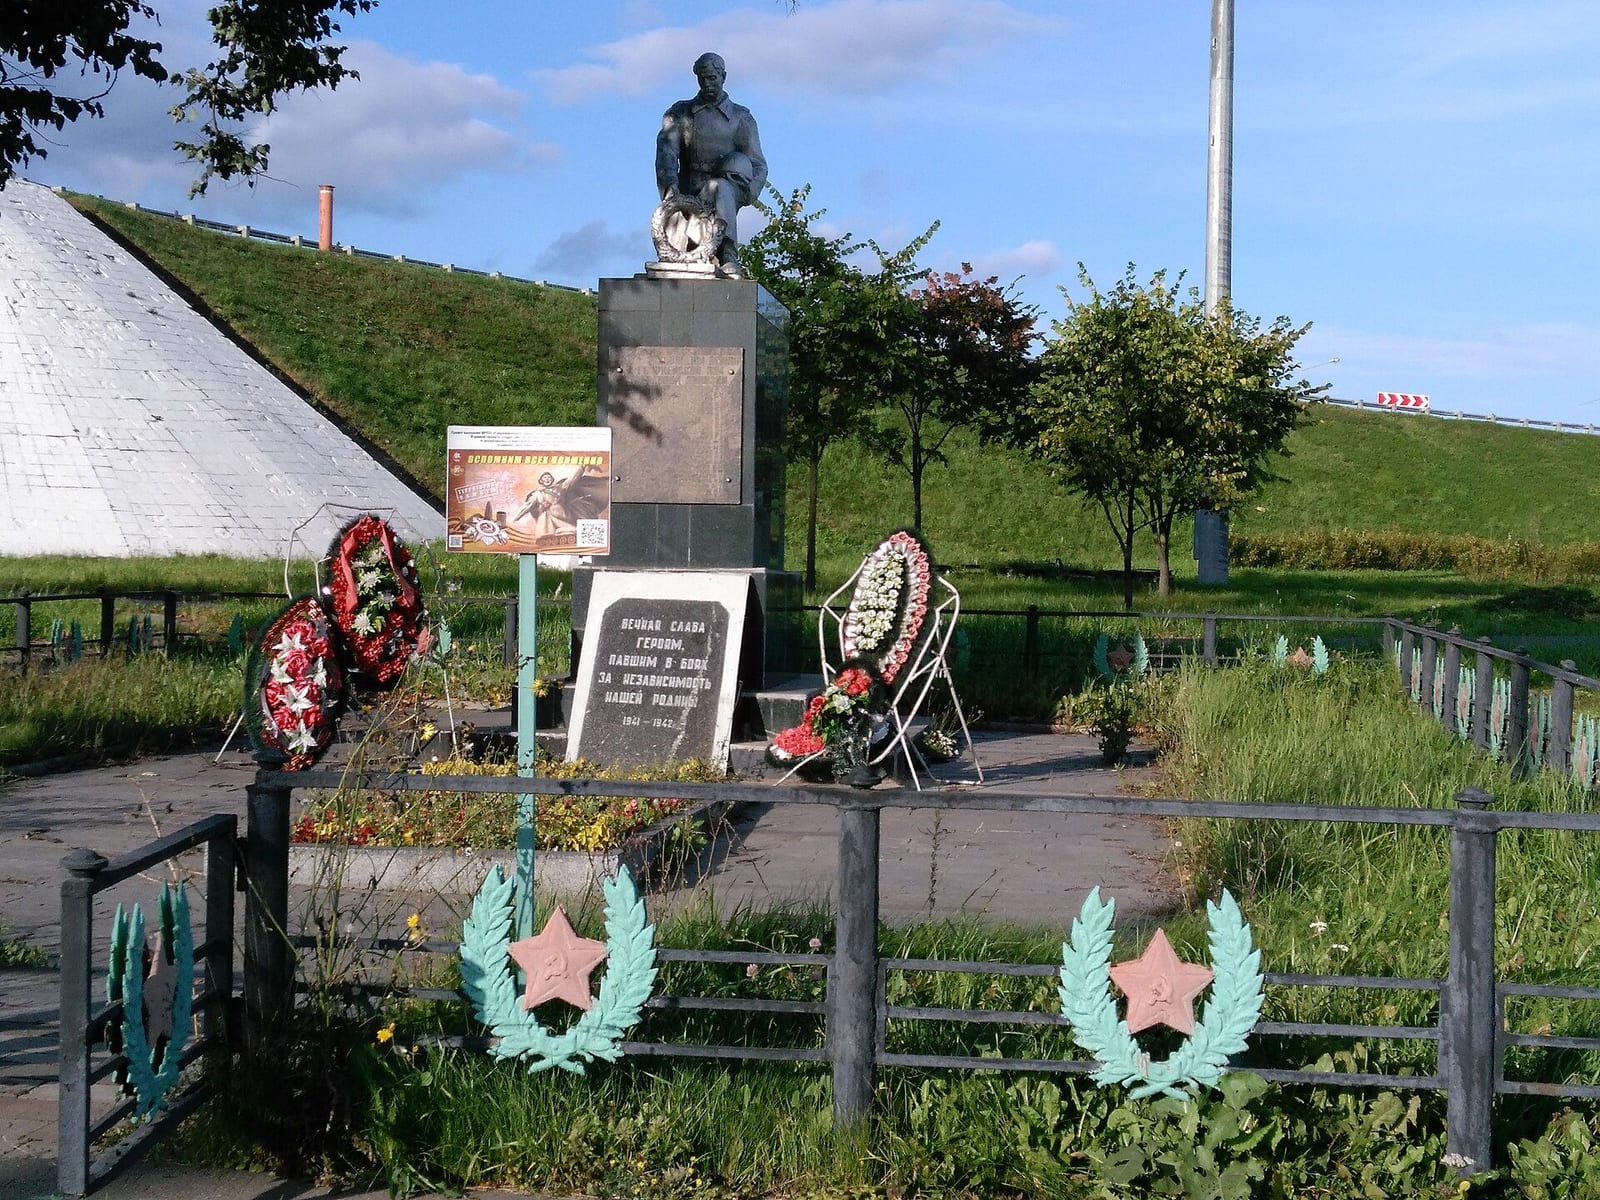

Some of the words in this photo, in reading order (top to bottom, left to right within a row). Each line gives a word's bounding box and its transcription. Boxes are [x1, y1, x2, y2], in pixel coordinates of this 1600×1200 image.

[467, 455, 523, 465] ВСПОМНИМ
[524, 455, 549, 465] ВСЕХ
[621, 618, 661, 630] ВЕЧНАЯ
[670, 620, 705, 633] СЛАВА
[608, 655, 657, 667] ПАВШИМ
[665, 658, 673, 669] В
[680, 657, 709, 671] БОЯХ
[598, 671, 612, 684] ЗА
[623, 673, 712, 690] НЕЗАВИСИМОСТЬ
[604, 690, 643, 705] НАШЕЙ
[652, 694, 698, 707] РОДИНЫ
